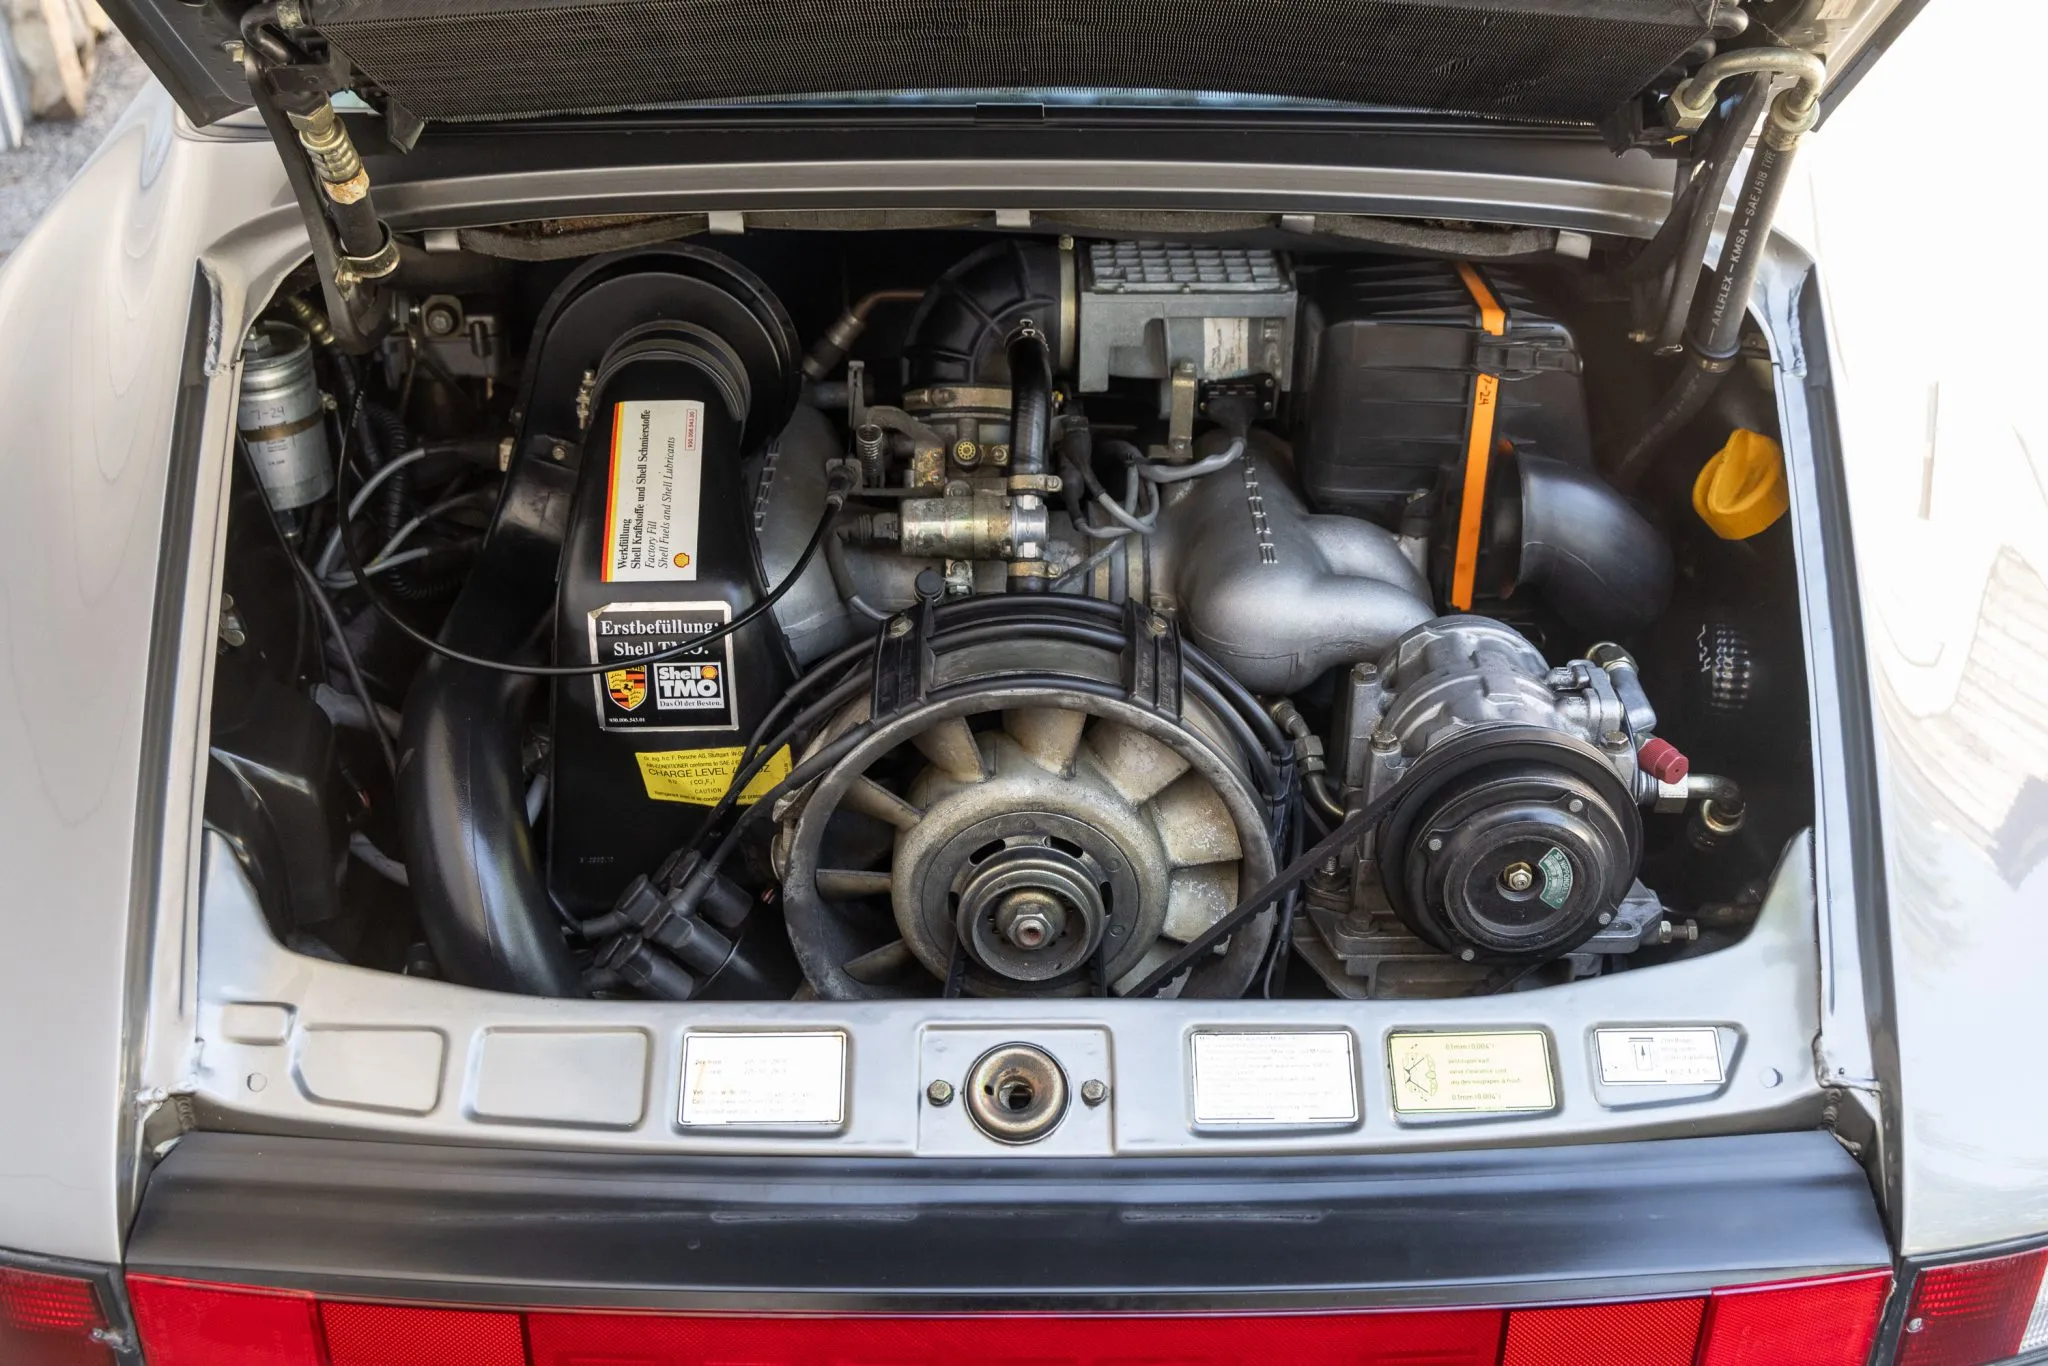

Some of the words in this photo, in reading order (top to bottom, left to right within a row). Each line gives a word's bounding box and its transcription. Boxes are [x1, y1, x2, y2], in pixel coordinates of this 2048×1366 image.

[1711, 276, 1733, 327] AALFLEX
[1729, 228, 1749, 265] KMSA
[1745, 195, 1760, 217] SAE
[1761, 150, 1776, 172] TYPE
[638, 409, 651, 463] Schmierstoffe
[663, 436, 676, 480] Lubricants
[637, 464, 647, 485] Shell
[636, 486, 646, 502] und
[661, 481, 673, 503] Shell
[661, 504, 672, 521] and
[633, 504, 645, 545] Kraftstoffe
[646, 520, 657, 535] Fill
[659, 522, 671, 545] Fuels
[617, 518, 632, 570] Werkfüllung
[644, 537, 658, 569] Factory
[631, 547, 642, 569] Shell
[658, 546, 669, 569] Shell
[614, 641, 654, 656] Shell
[658, 665, 702, 680] Shell
[660, 679, 718, 698] TMO
[648, 768, 693, 778] CHARGE
[695, 767, 728, 776] LEVEL
